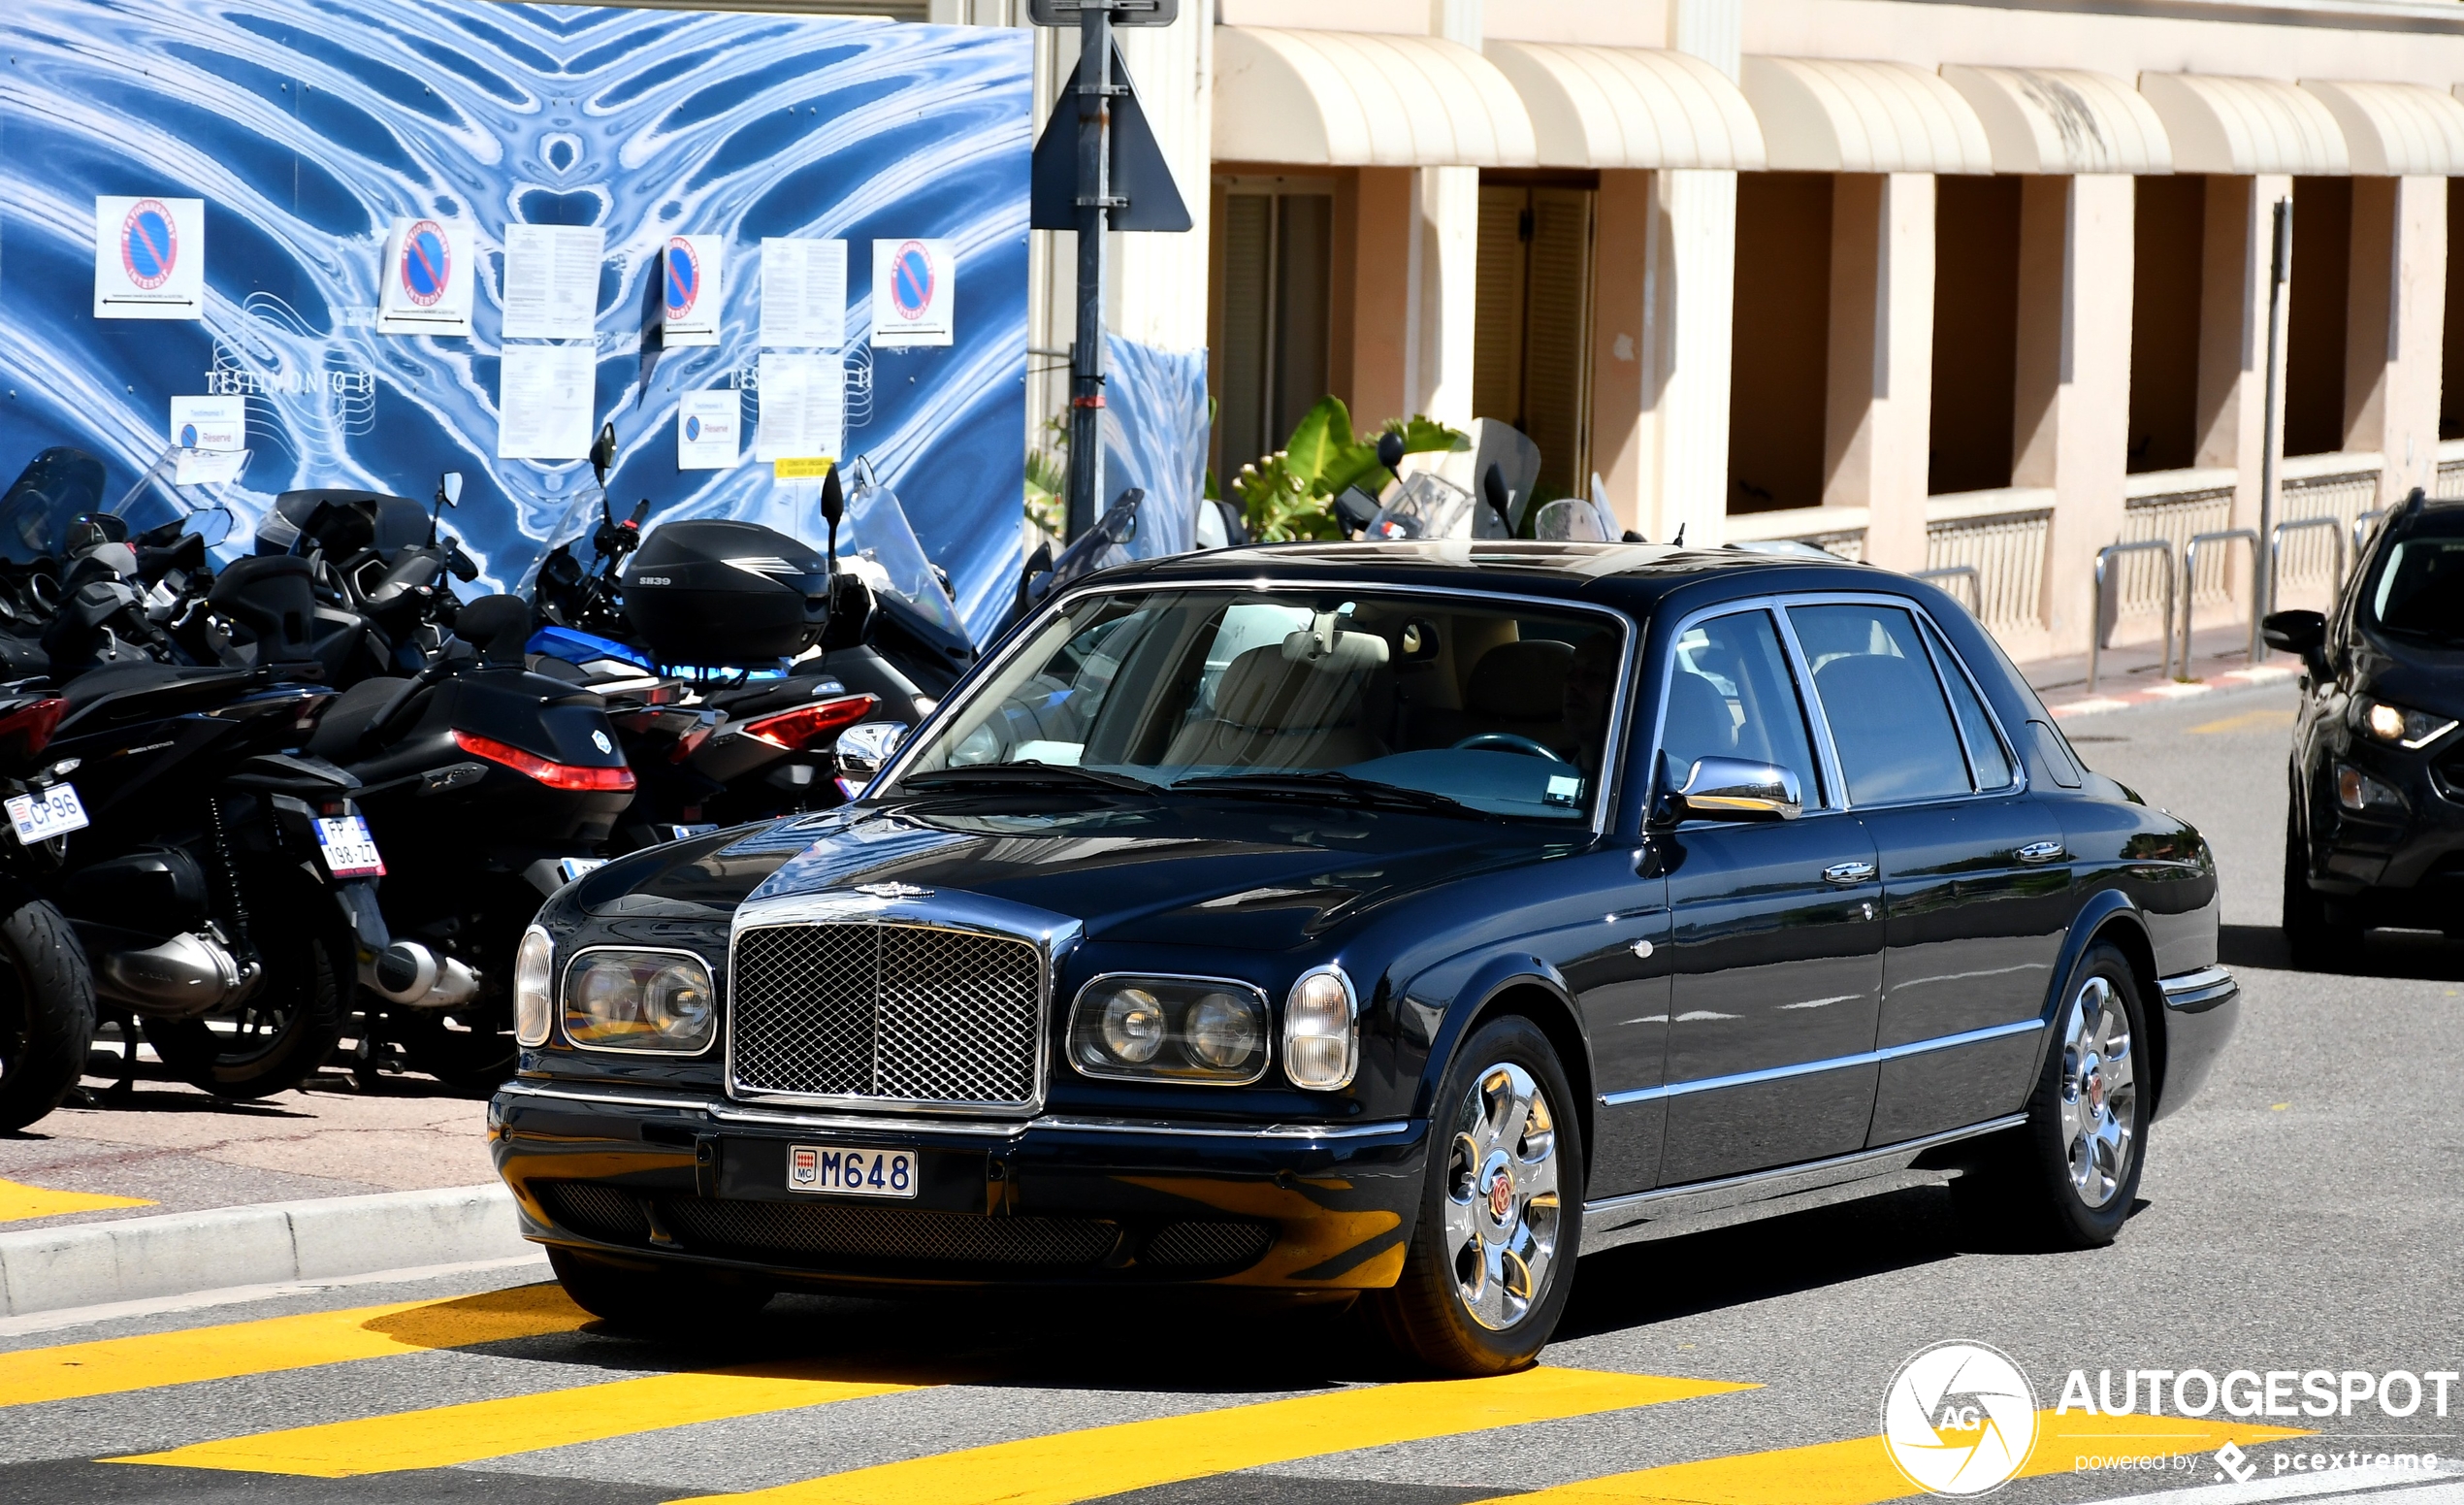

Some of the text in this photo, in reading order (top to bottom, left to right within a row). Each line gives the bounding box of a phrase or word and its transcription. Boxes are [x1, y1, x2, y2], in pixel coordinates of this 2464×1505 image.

[122, 201, 178, 242] STATIONNEMENT
[128, 268, 170, 289] INTERDIT
[405, 285, 443, 306] INTERDIT
[205, 371, 375, 394] TESTIMONIO II
[639, 576, 671, 586] SH39
[30, 794, 78, 825] CP96
[797, 1168, 813, 1179] MC
[821, 1151, 910, 1191] M648
